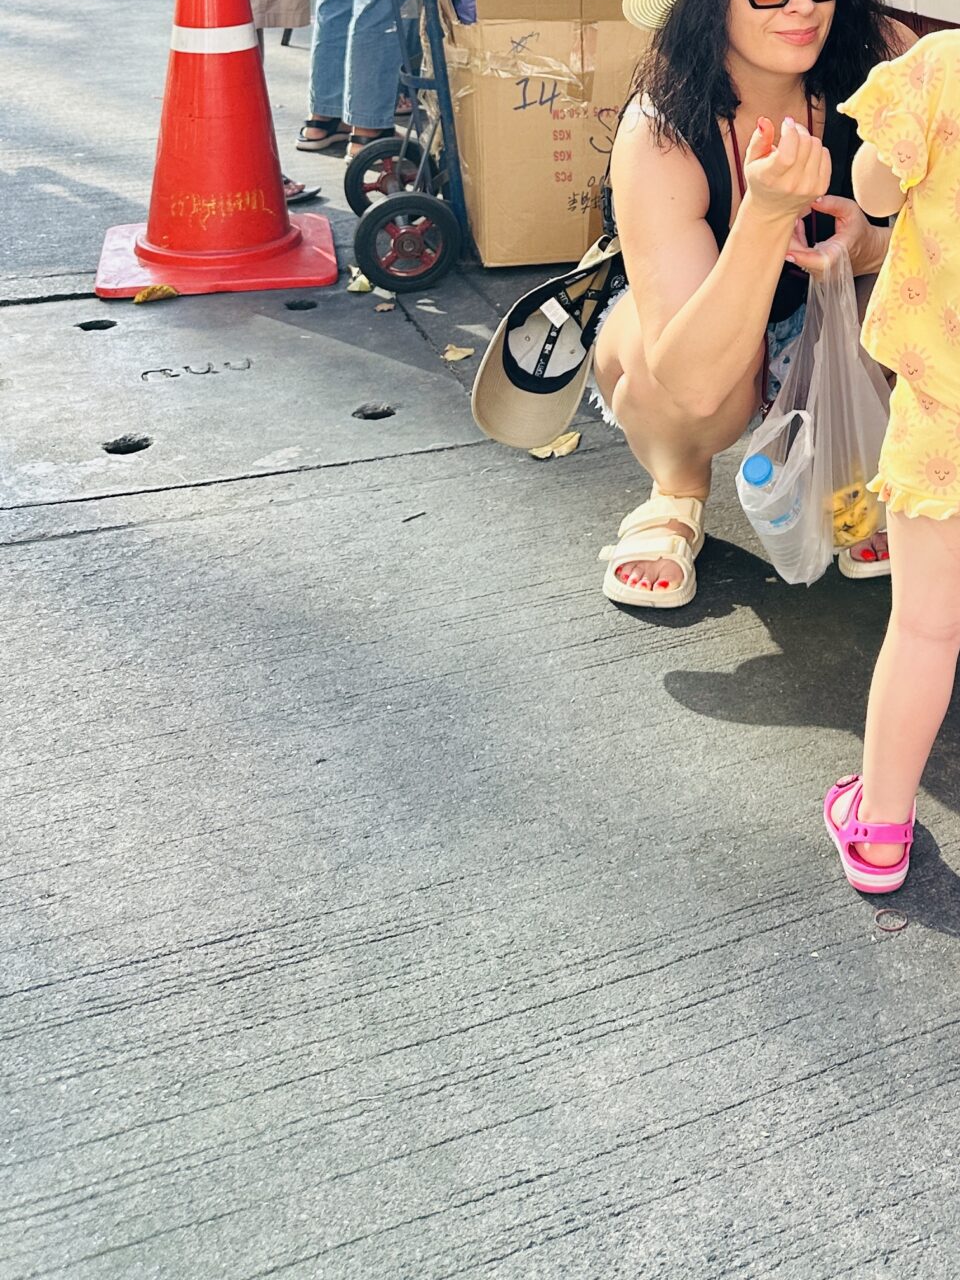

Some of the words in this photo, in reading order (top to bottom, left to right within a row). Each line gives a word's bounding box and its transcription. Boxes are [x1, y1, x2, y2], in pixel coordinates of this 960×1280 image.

[553, 129, 571, 141] KGS
[553, 150, 572, 161] KGS
[555, 171, 573, 183] PCS
